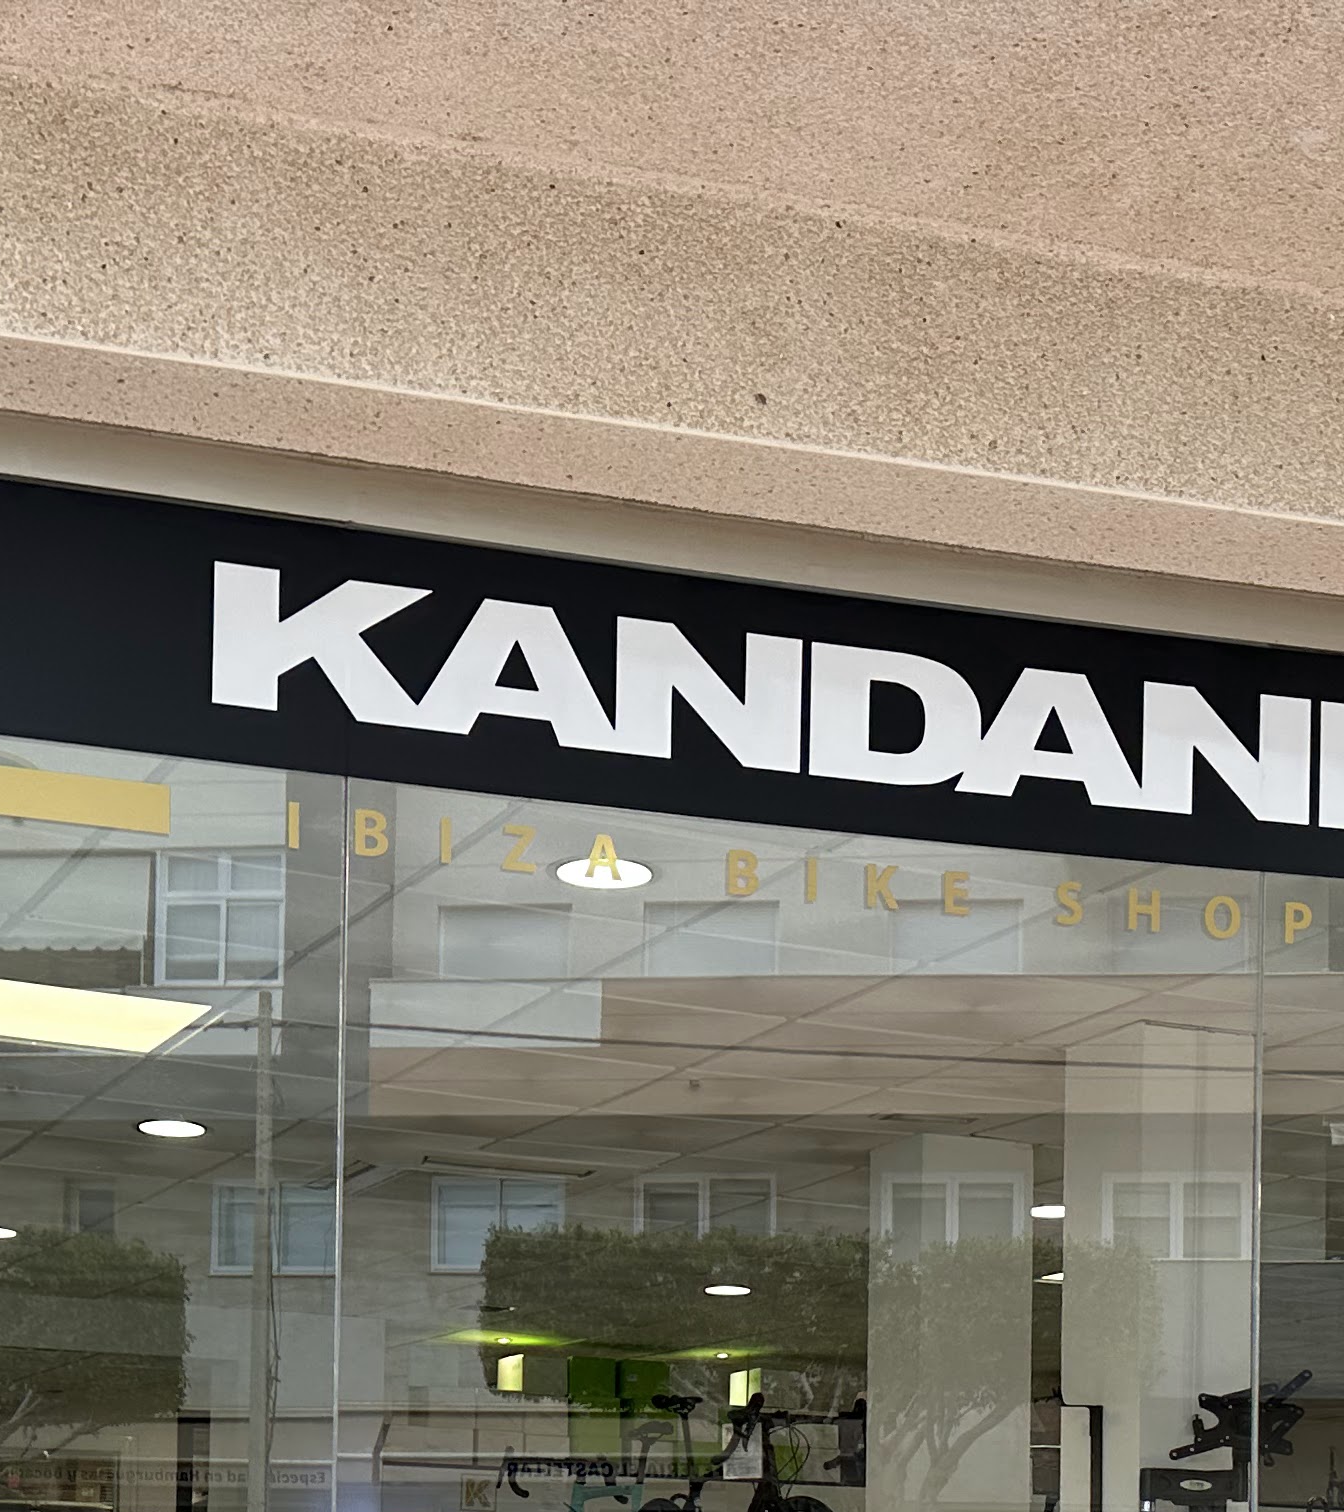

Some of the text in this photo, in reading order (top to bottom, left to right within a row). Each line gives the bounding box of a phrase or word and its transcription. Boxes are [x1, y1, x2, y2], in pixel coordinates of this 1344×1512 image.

[288, 804, 1313, 943] IBIZA BIKE SHOP
